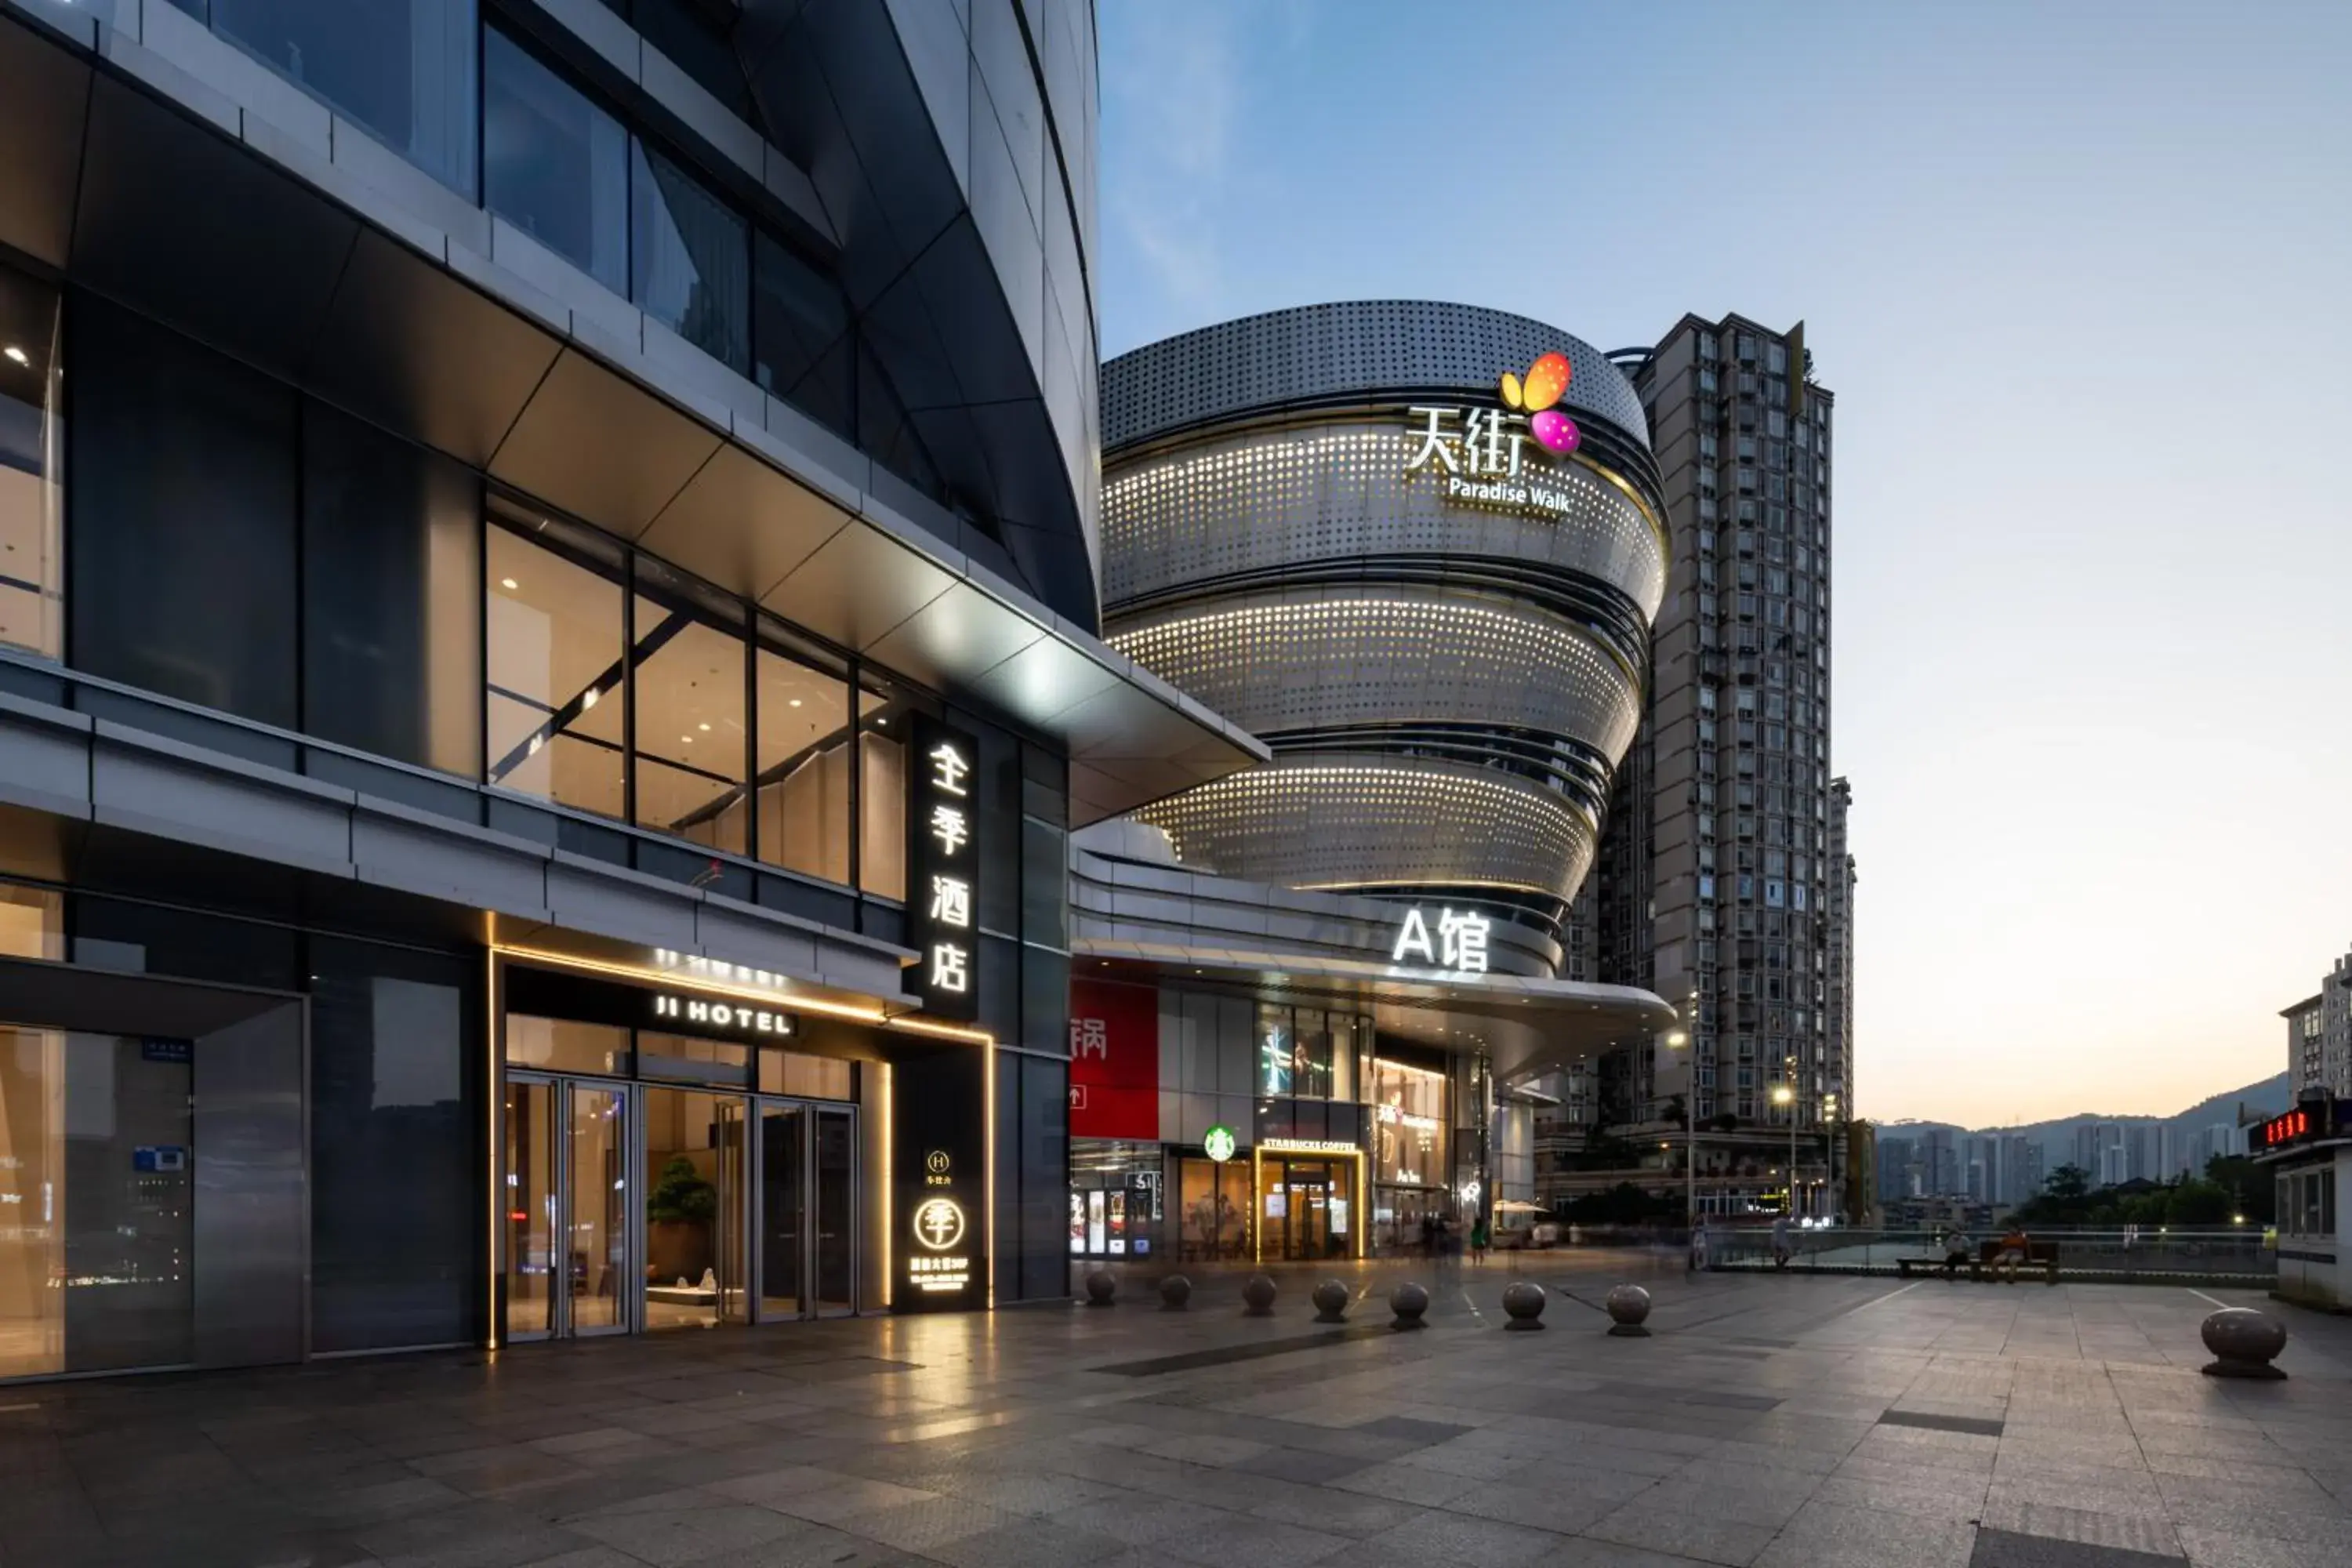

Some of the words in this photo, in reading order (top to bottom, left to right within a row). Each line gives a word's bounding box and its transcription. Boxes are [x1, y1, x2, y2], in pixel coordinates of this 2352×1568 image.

[1404, 406, 1525, 476] 天街
[1450, 477, 1526, 503] Paradise
[1530, 486, 1570, 512] Walk
[930, 744, 969, 992] 全季酒店
[1392, 906, 1490, 972] A馆
[688, 1000, 790, 1034] HOTEL
